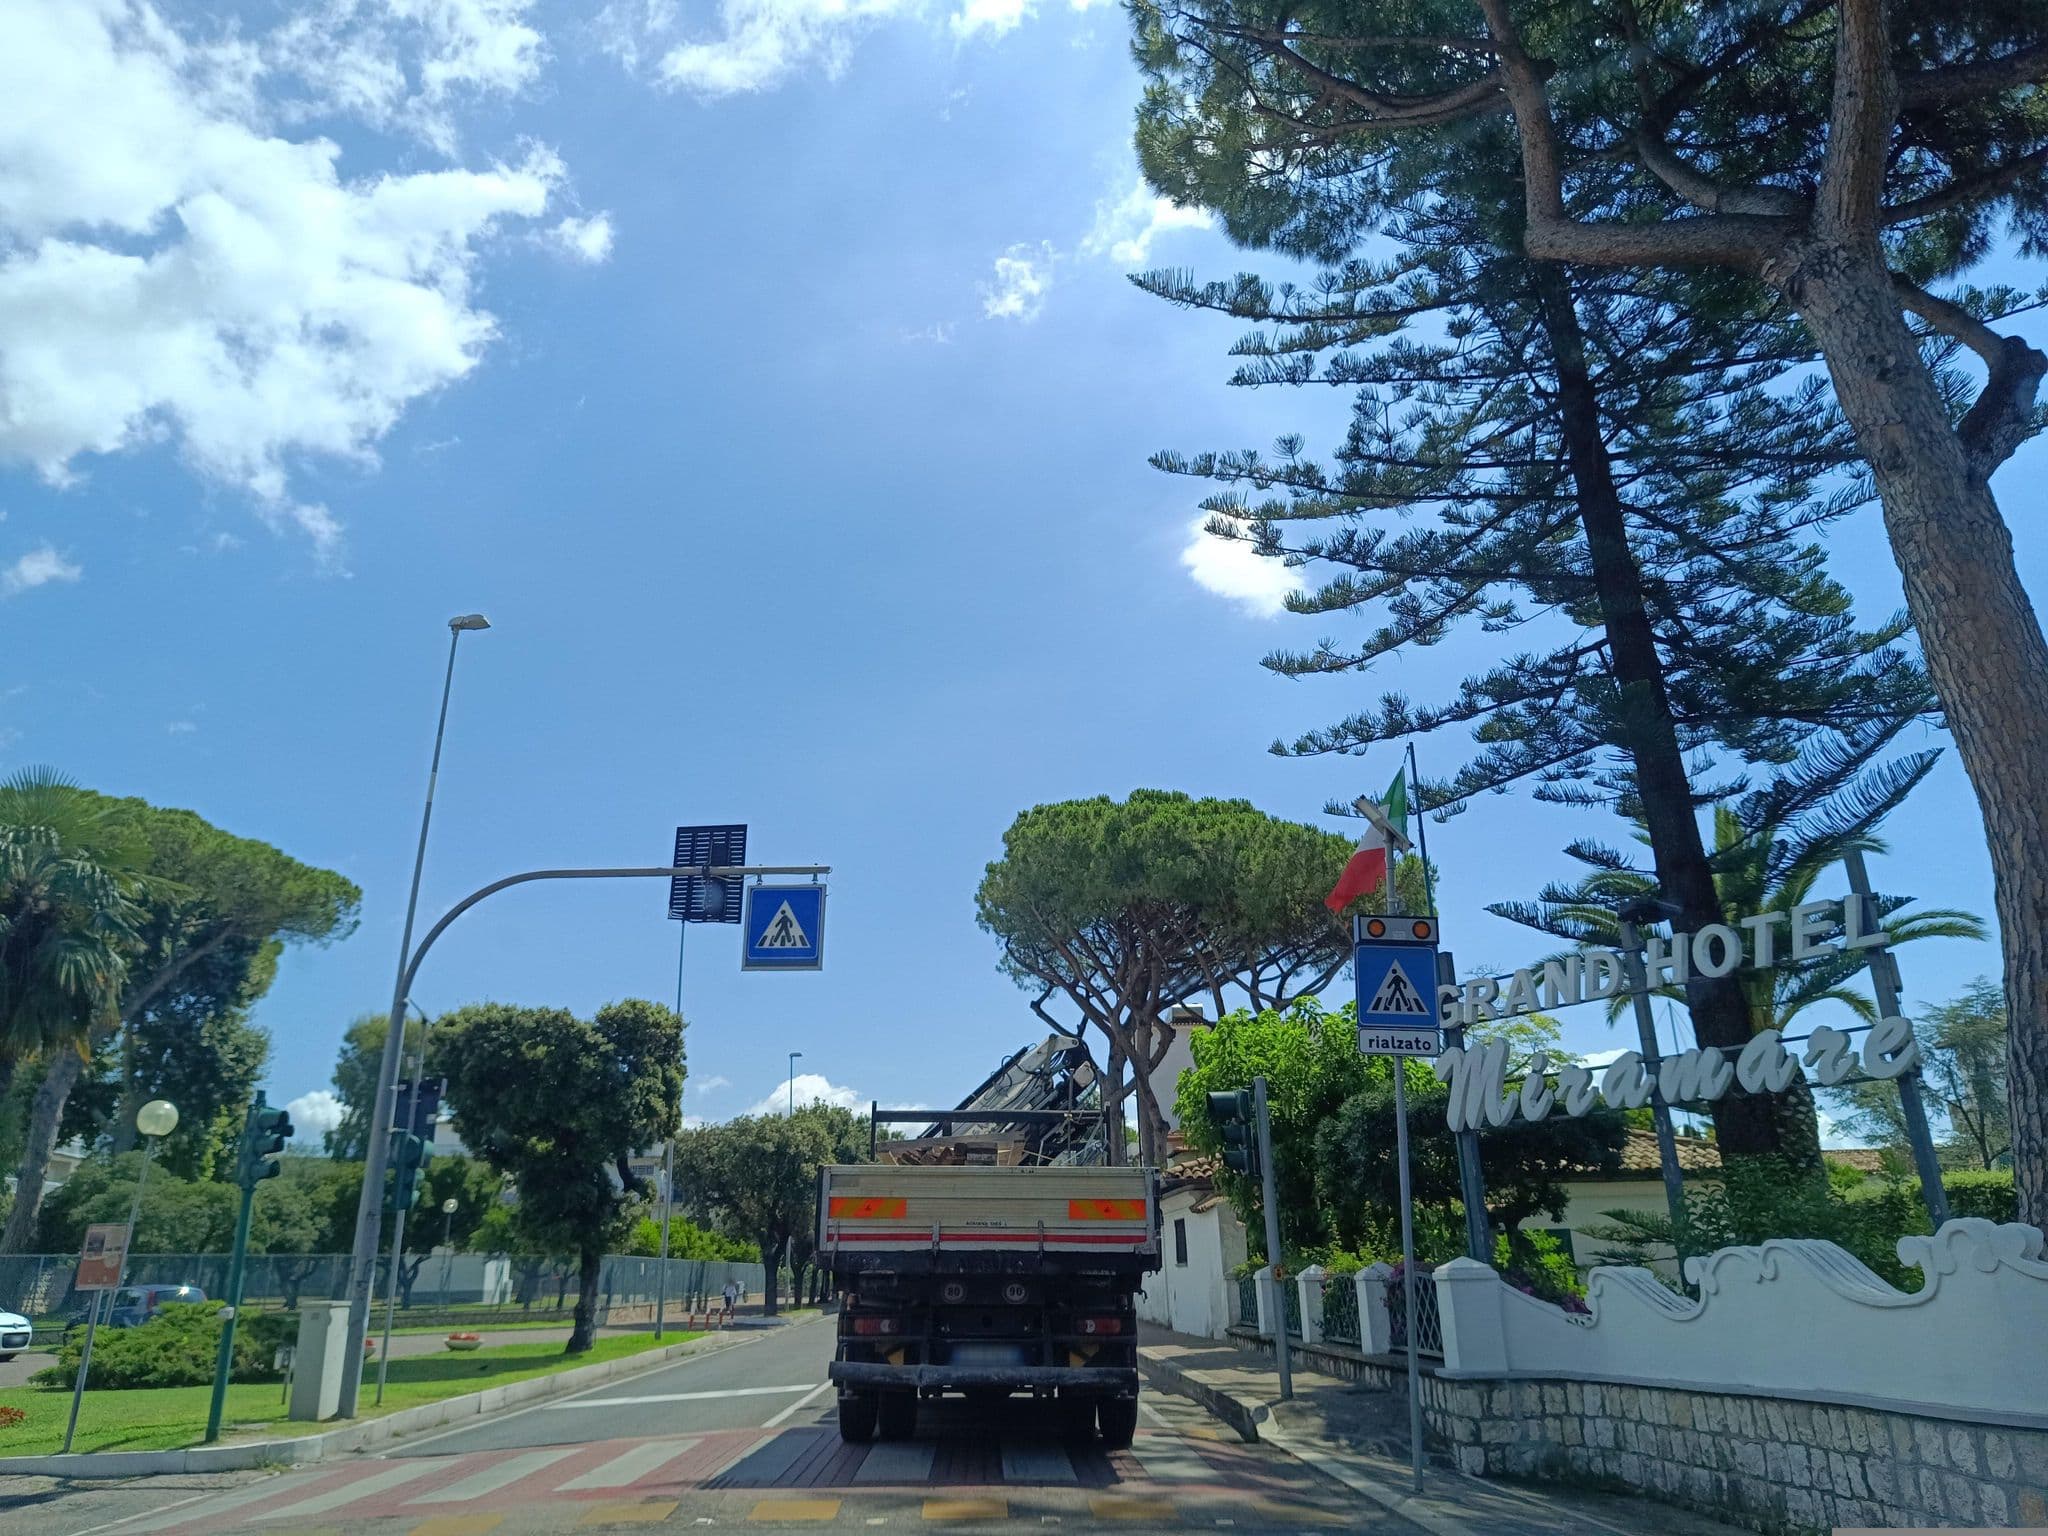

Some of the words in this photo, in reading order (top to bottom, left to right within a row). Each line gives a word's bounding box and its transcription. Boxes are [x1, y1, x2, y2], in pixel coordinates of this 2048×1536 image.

[1438, 950, 1624, 1030] GRAND
[1646, 893, 1890, 989] HOTEL
[1368, 1035, 1432, 1051] rialzato
[1436, 1015, 1921, 1133] Miramare
[947, 1286, 961, 1297] 80
[1009, 1286, 1023, 1297] 90
